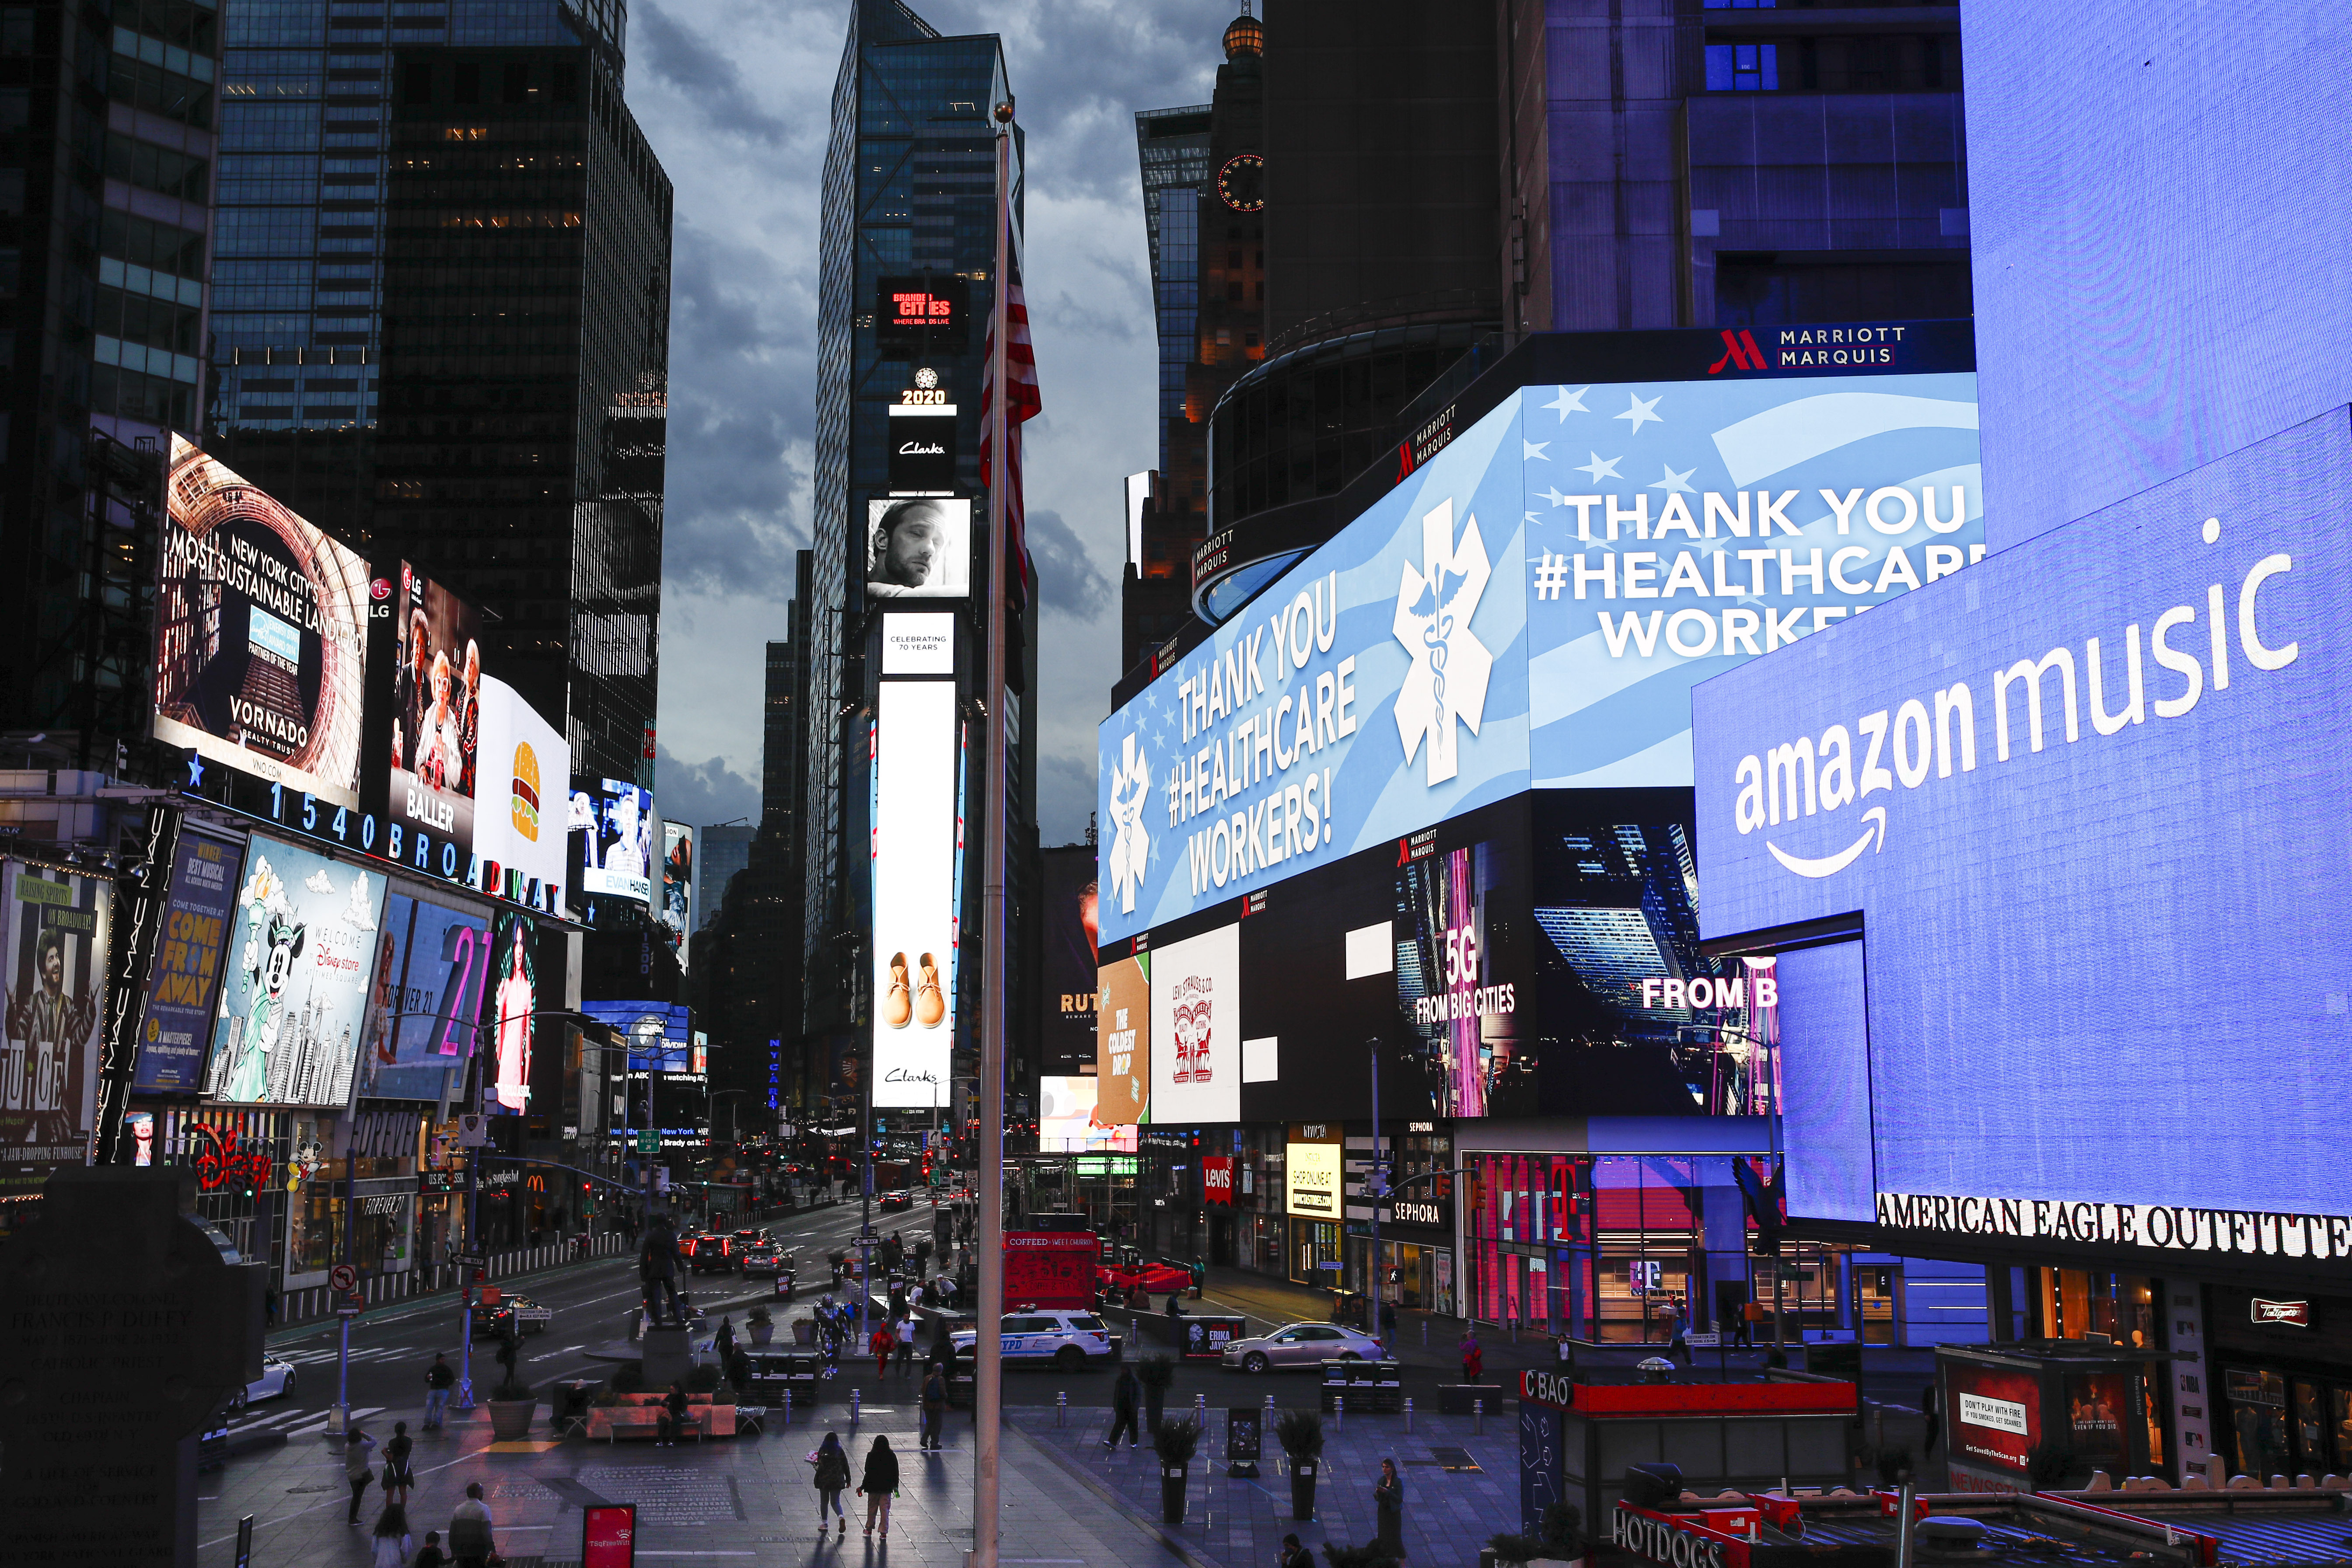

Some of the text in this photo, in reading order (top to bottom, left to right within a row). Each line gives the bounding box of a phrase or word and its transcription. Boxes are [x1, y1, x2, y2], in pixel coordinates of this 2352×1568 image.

[1780, 327, 1905, 345] MARRIOTT
[1781, 349, 1891, 366] MARQUIS
[902, 390, 946, 405] 2020
[1416, 404, 1456, 446] MARRIOTT
[1416, 427, 1452, 465] MARQUIS
[1564, 485, 1966, 541] THANK YOU
[1196, 529, 1234, 563] MARRIOTT
[231, 534, 319, 604] NEW YORK CITY'S
[1196, 550, 1227, 580] MARQUIS
[171, 527, 363, 657] MOST SUSTAINABLE LANDLORD
[412, 575, 421, 596] LG
[370, 604, 389, 618] LG
[269, 618, 299, 643] ENERGY STAR
[268, 635, 296, 657] AWARD 2014
[1158, 637, 1178, 660] MARRIOTT
[248, 642, 298, 676] PARTNER OF THE YEAR
[1158, 652, 1176, 672] MARQUIS
[1178, 570, 1337, 745] THANK YOU
[1734, 518, 2299, 835] amazon music
[230, 695, 308, 748] VORNADO
[242, 729, 270, 746] REALTY
[1169, 654, 1357, 829] #HEALTHCARE
[253, 758, 282, 780] VNO.COM
[408, 771, 424, 790] I'M A
[406, 787, 454, 834] BALLER
[1188, 767, 1332, 897] WORKERS!
[1411, 829, 1437, 847] MARRIOTT
[198, 842, 222, 862] WINNER!
[1411, 842, 1435, 859] MARQUIS
[187, 858, 224, 881] BEST MUSICAL
[388, 822, 562, 914] BROADWAY
[21, 880, 68, 904] RAISING SPIRITS
[211, 880, 223, 891] AMERICA
[1251, 890, 1268, 903] MARRIOTT
[173, 899, 188, 910] COME
[190, 903, 217, 916] TOGETHER
[1251, 901, 1266, 913] MARQUIS
[48, 908, 91, 930] ON BROADWAY!
[169, 910, 222, 947] COME
[315, 926, 361, 949] WELCOME
[1137, 933, 1149, 943] MARRIOTT
[1137, 943, 1148, 951] MARQUIS
[161, 939, 217, 978] FROM
[316, 943, 359, 975] Disney store
[1446, 925, 1477, 986] 5G
[315, 970, 332, 981] TIMES
[336, 974, 358, 985] SQUARE
[1173, 984, 1182, 1000] LEVI
[1183, 975, 1201, 997] STRAUSS
[154, 971, 212, 1007] AWAY
[439, 926, 493, 1058] 21
[1642, 977, 1744, 1009] FROM
[160, 1006, 184, 1014] REMARKABLE
[423, 992, 433, 1014] 21
[1174, 1002, 1211, 1023] ORIGINAL RIVETED
[1416, 983, 1515, 1025] FROM BIG CITIES
[1116, 1008, 1129, 1031] THE
[162, 1031, 192, 1045] MASTERPIECE!
[1108, 1029, 1136, 1055] COLDEST
[1112, 1053, 1131, 1076] DROP
[668, 1074, 697, 1083] watching
[1303, 1124, 1327, 1139] INVICTA
[1409, 1122, 1433, 1132] SEPHORA
[8, 1146, 51, 1162] JAW-DROPPING
[664, 1139, 685, 1147] Brady
[493, 1171, 511, 1187] sunglass
[1293, 1170, 1332, 1186] SHOP ONLINE AT
[365, 1196, 404, 1215] FOREVER 21
[1293, 1193, 1332, 1207] INVICTASTORES.COM
[1395, 1202, 1439, 1223] SEPHORA
[1877, 1194, 2352, 1257] AMERICAN EAGLE OUTFITTE
[2260, 1304, 2300, 1320] Tailgate
[1000, 1340, 1022, 1350] YPD
[1209, 1331, 1230, 1341] ERIKA
[1539, 1372, 1568, 1405] BAO
[2187, 1375, 2200, 1394] NBA
[1965, 1400, 2022, 1418] DON'T PLAY WITH FIRE.
[1979, 1413, 1995, 1423] SMOKED,
[2004, 1418, 2023, 1428] SCANNED.
[1973, 1446, 2017, 1463] SavedByTheScan.org
[1613, 1507, 1726, 1568] HOTDOGS
